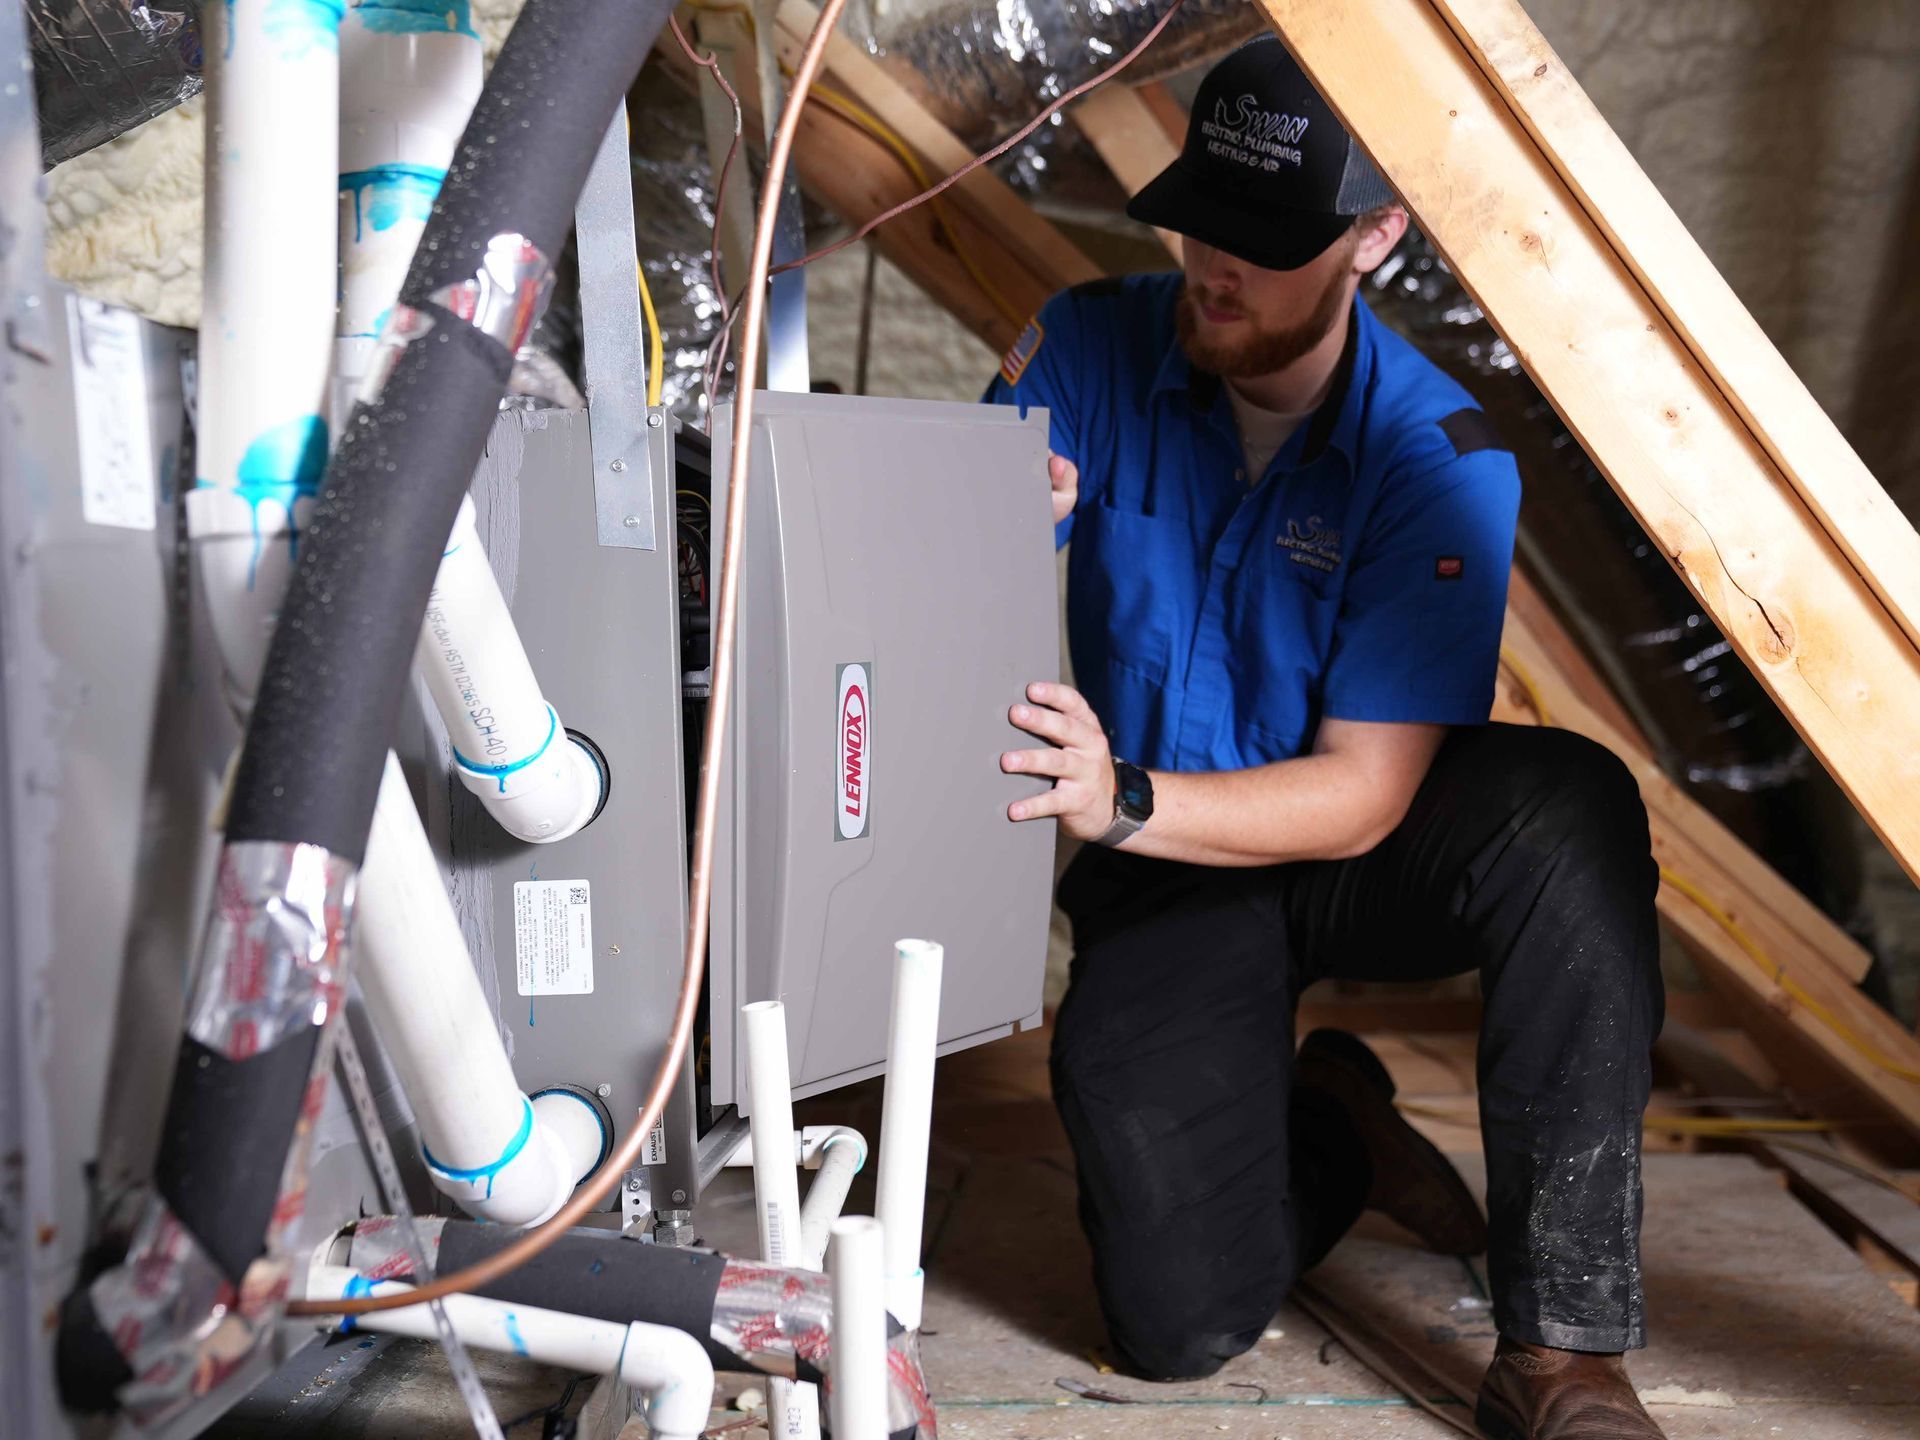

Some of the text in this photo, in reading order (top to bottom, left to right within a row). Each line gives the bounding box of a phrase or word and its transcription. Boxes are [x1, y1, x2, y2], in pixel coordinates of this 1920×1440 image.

[1259, 158, 1280, 172] AIR
[444, 648, 466, 676] ASTM
[470, 706, 498, 736] SCH
[484, 734, 507, 757] 40
[845, 711, 862, 818] LENNOX
